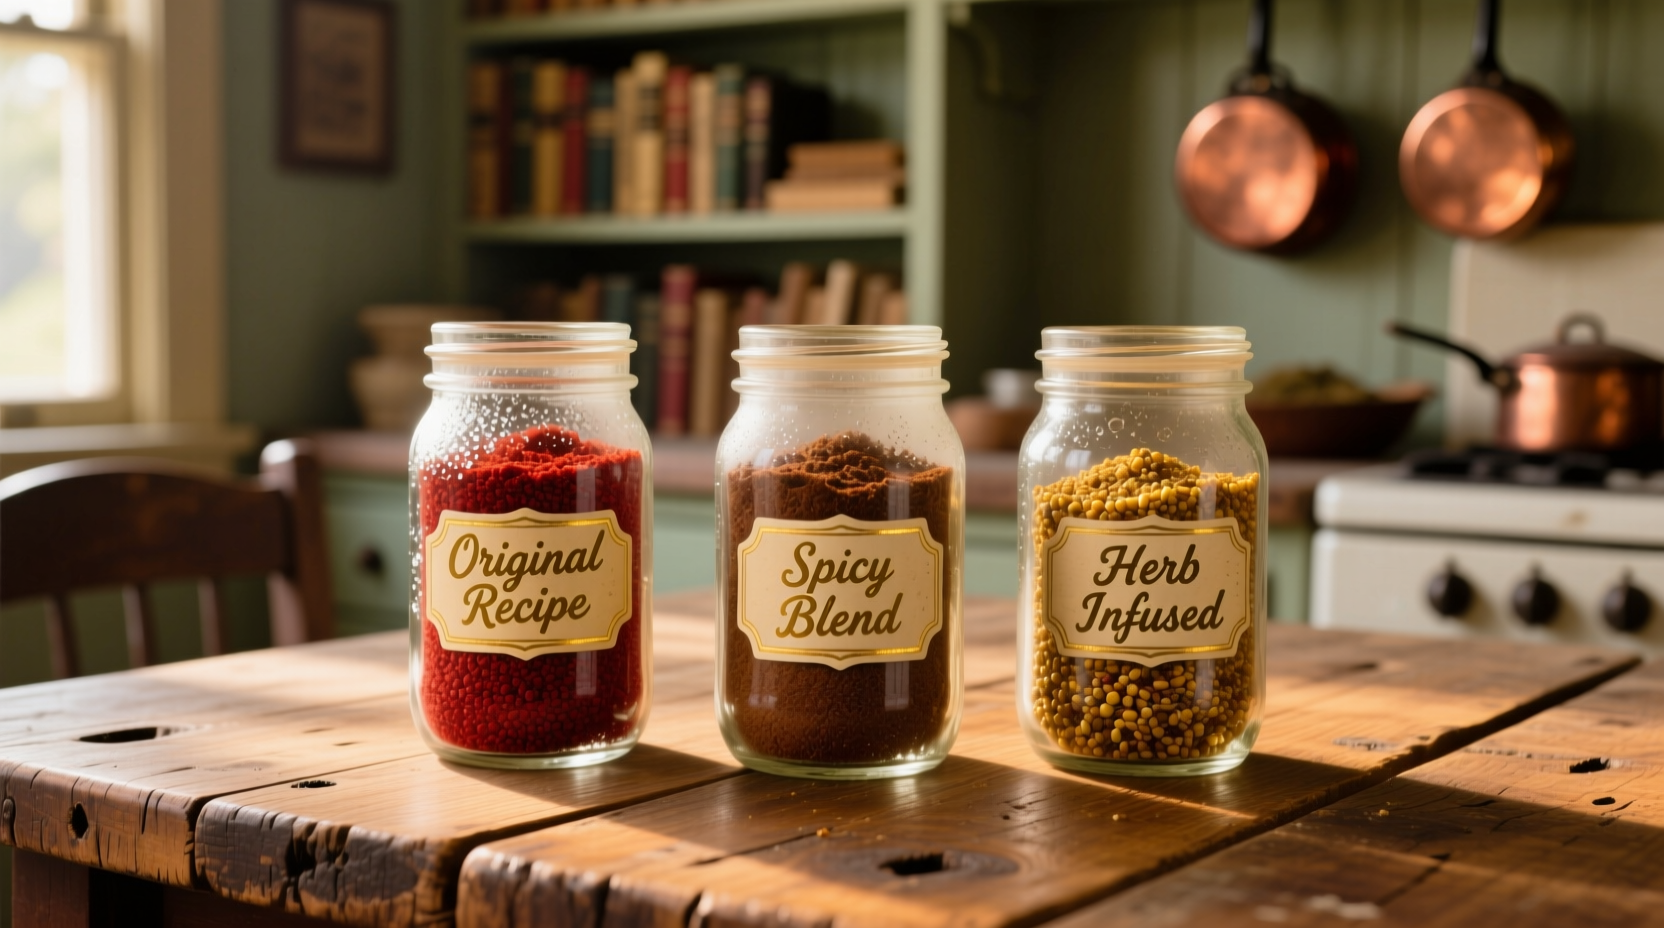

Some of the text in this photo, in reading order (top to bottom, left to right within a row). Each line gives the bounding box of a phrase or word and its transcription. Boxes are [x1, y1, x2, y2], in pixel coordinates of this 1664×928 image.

[449, 529, 605, 592] Original
[781, 541, 895, 598] Spicy
[1093, 544, 1200, 586] Herb
[462, 583, 591, 634] Recipe
[775, 592, 904, 638] Blend
[1075, 589, 1226, 644] Infused
